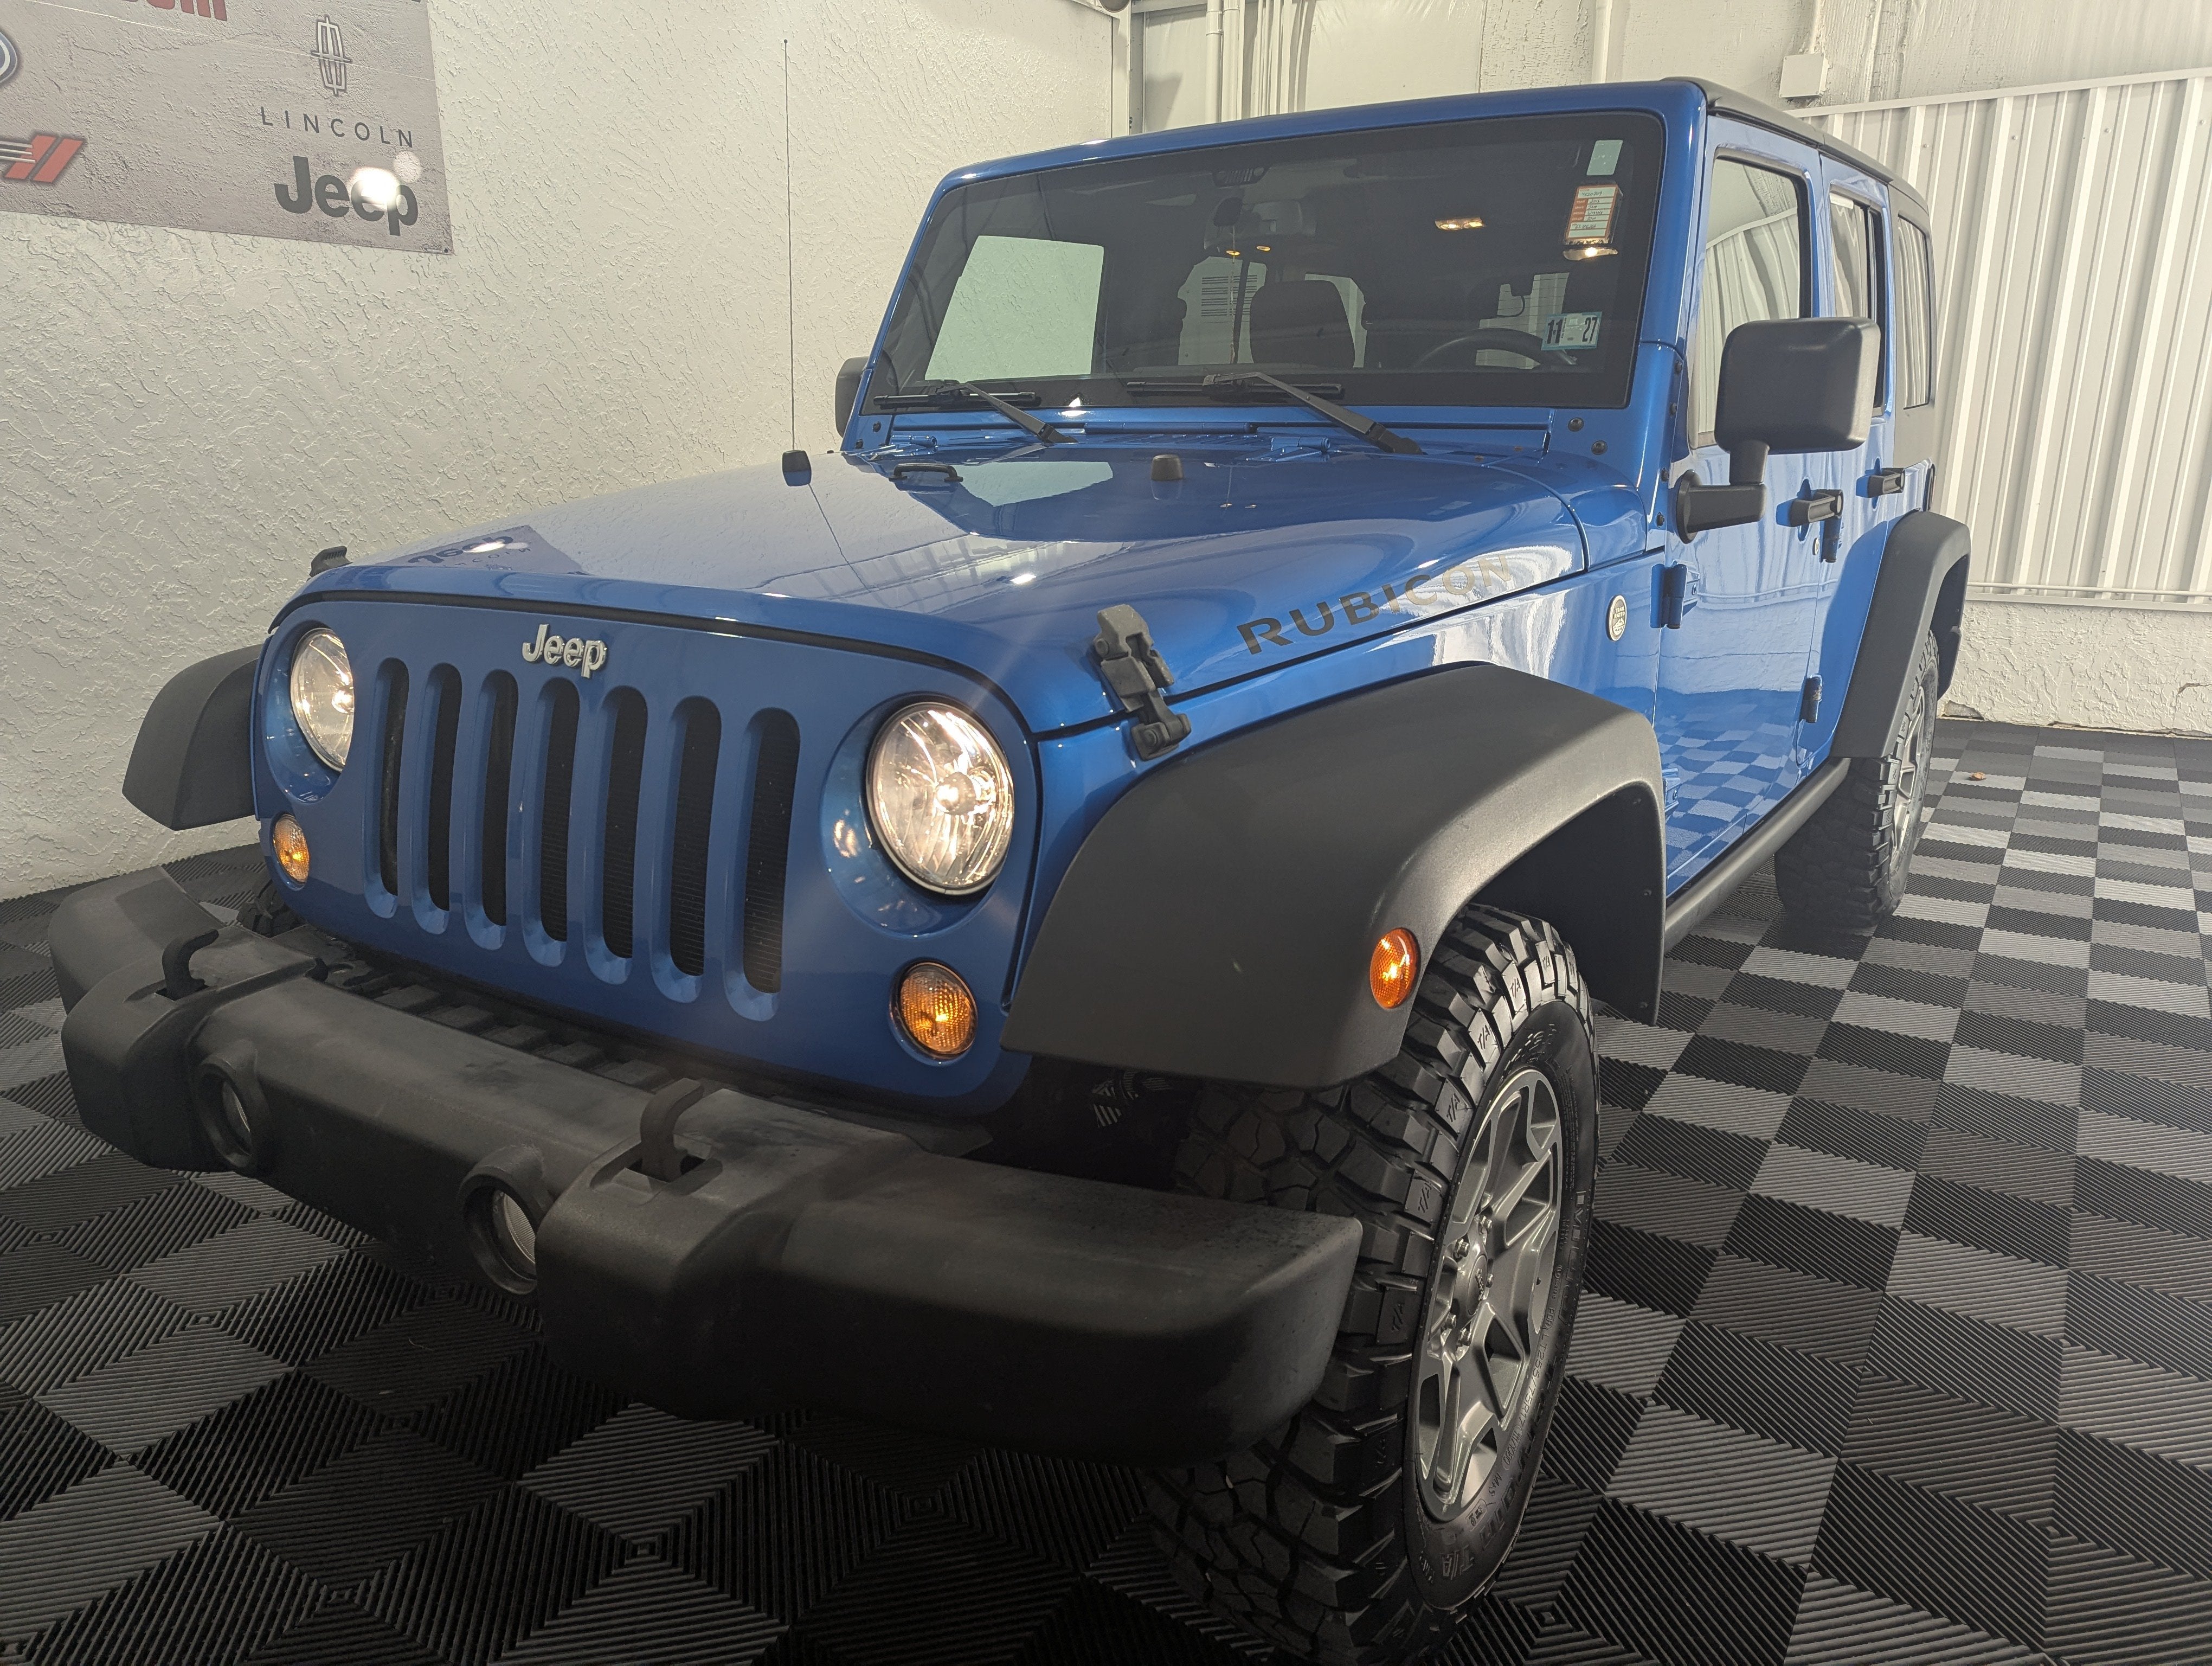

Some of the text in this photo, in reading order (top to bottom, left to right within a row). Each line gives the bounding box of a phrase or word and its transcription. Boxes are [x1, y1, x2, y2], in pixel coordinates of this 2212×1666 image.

[260, 106, 413, 148] LINCOLN
[274, 155, 418, 236] Jeep
[1547, 319, 1563, 344] 11
[1582, 317, 1598, 342] 27
[1236, 554, 1512, 655] RUBICON
[522, 623, 607, 679] Jeep
